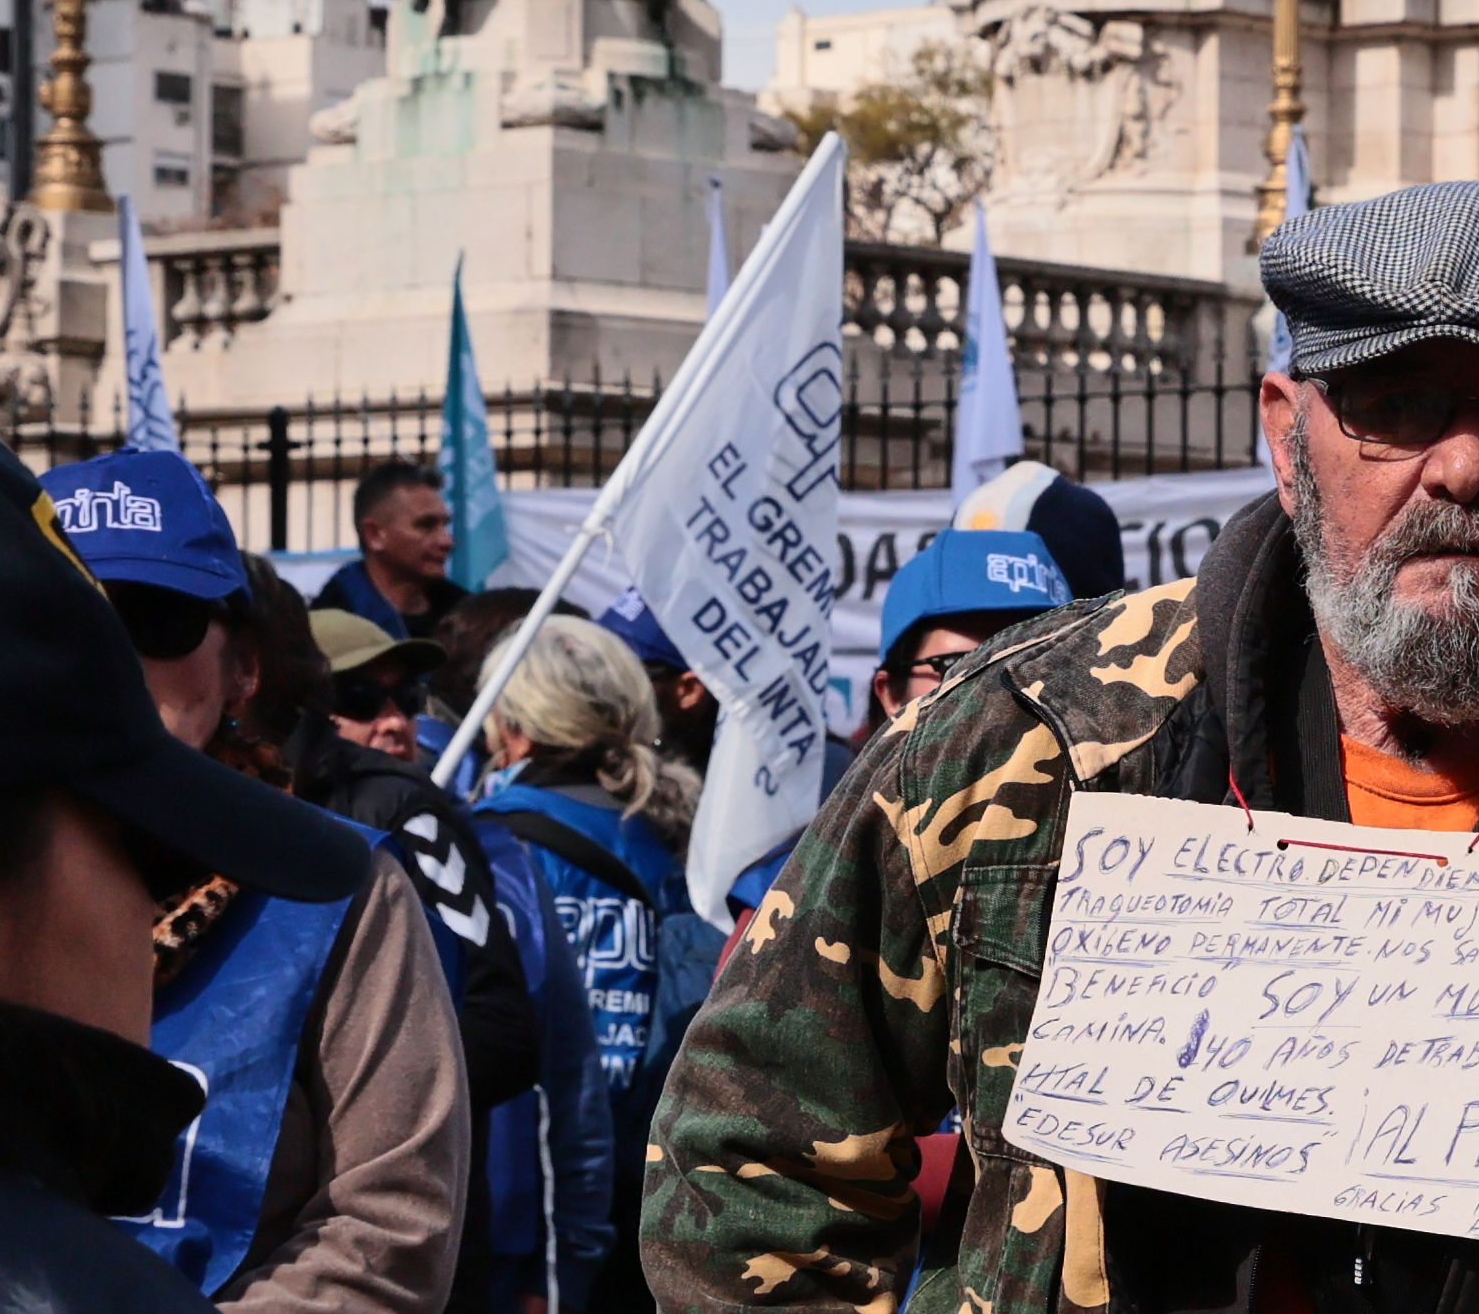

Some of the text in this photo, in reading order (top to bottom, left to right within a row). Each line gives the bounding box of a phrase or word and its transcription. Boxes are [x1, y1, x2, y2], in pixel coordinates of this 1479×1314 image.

[54, 480, 162, 533] inta
[707, 441, 748, 501] EL
[747, 496, 833, 615] GREM
[692, 597, 816, 767] DEL INTA
[1057, 827, 1155, 884] SOY
[1259, 894, 1348, 924] TOTAL
[1374, 939, 1432, 964] NOS
[1258, 970, 1360, 1031] SOY
[1368, 980, 1418, 1007] UN
[1203, 1034, 1254, 1072] 40
[1262, 1035, 1360, 1070] AÑOS
[1019, 1063, 1109, 1094] HTAL
[1124, 1075, 1185, 1103] DE
